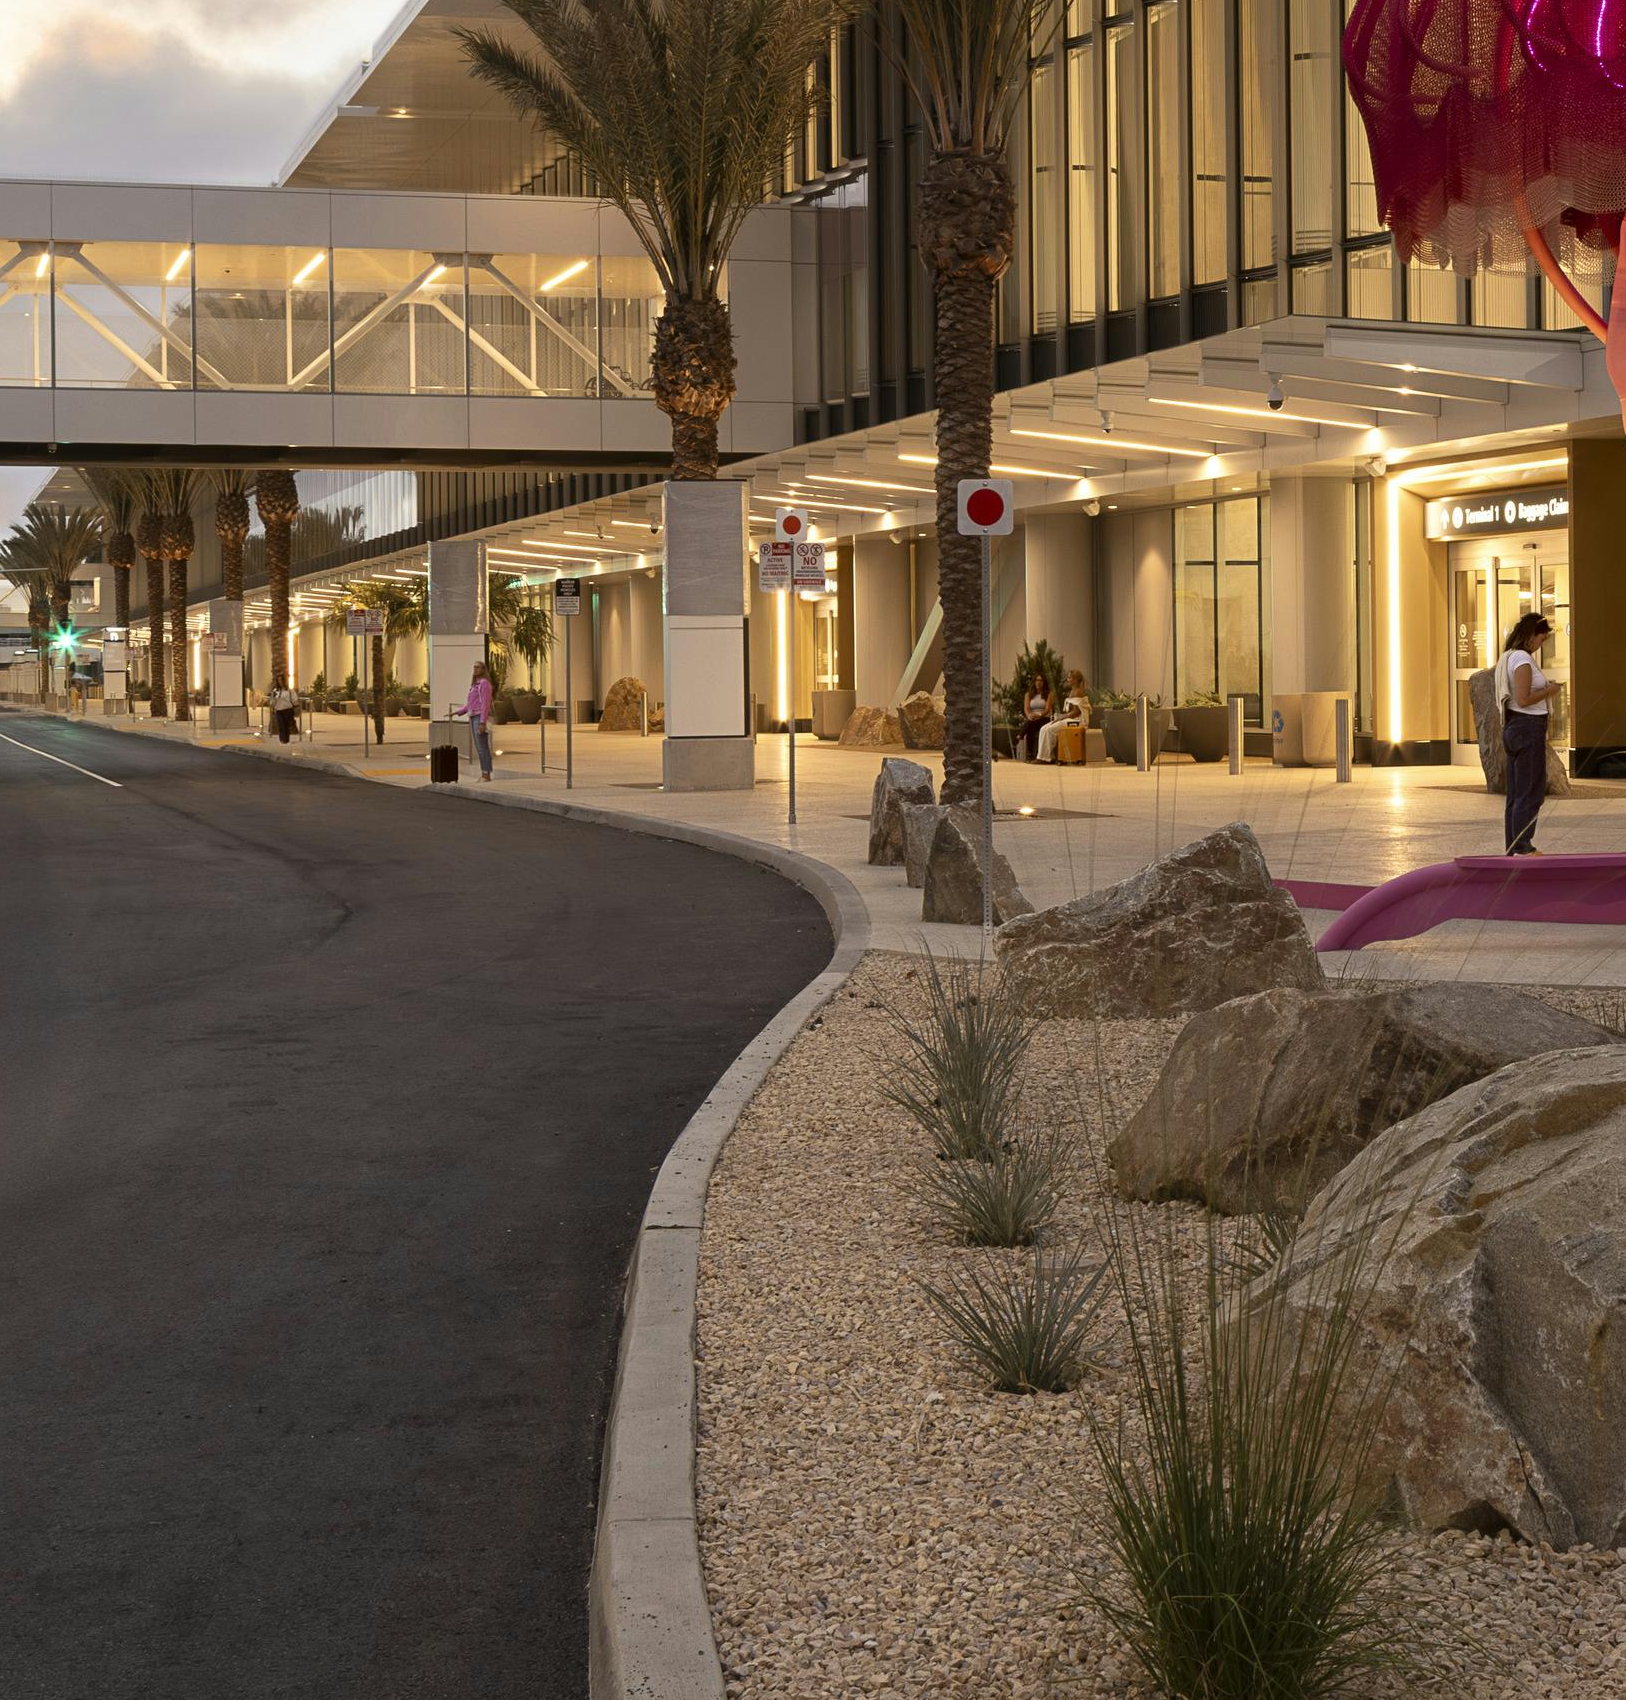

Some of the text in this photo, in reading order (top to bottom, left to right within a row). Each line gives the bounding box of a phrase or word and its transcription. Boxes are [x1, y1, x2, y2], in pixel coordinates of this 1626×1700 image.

[1465, 505, 1499, 524] Terminal 1
[1518, 497, 1569, 522] Baggage Claim
[803, 557, 817, 565] NO
